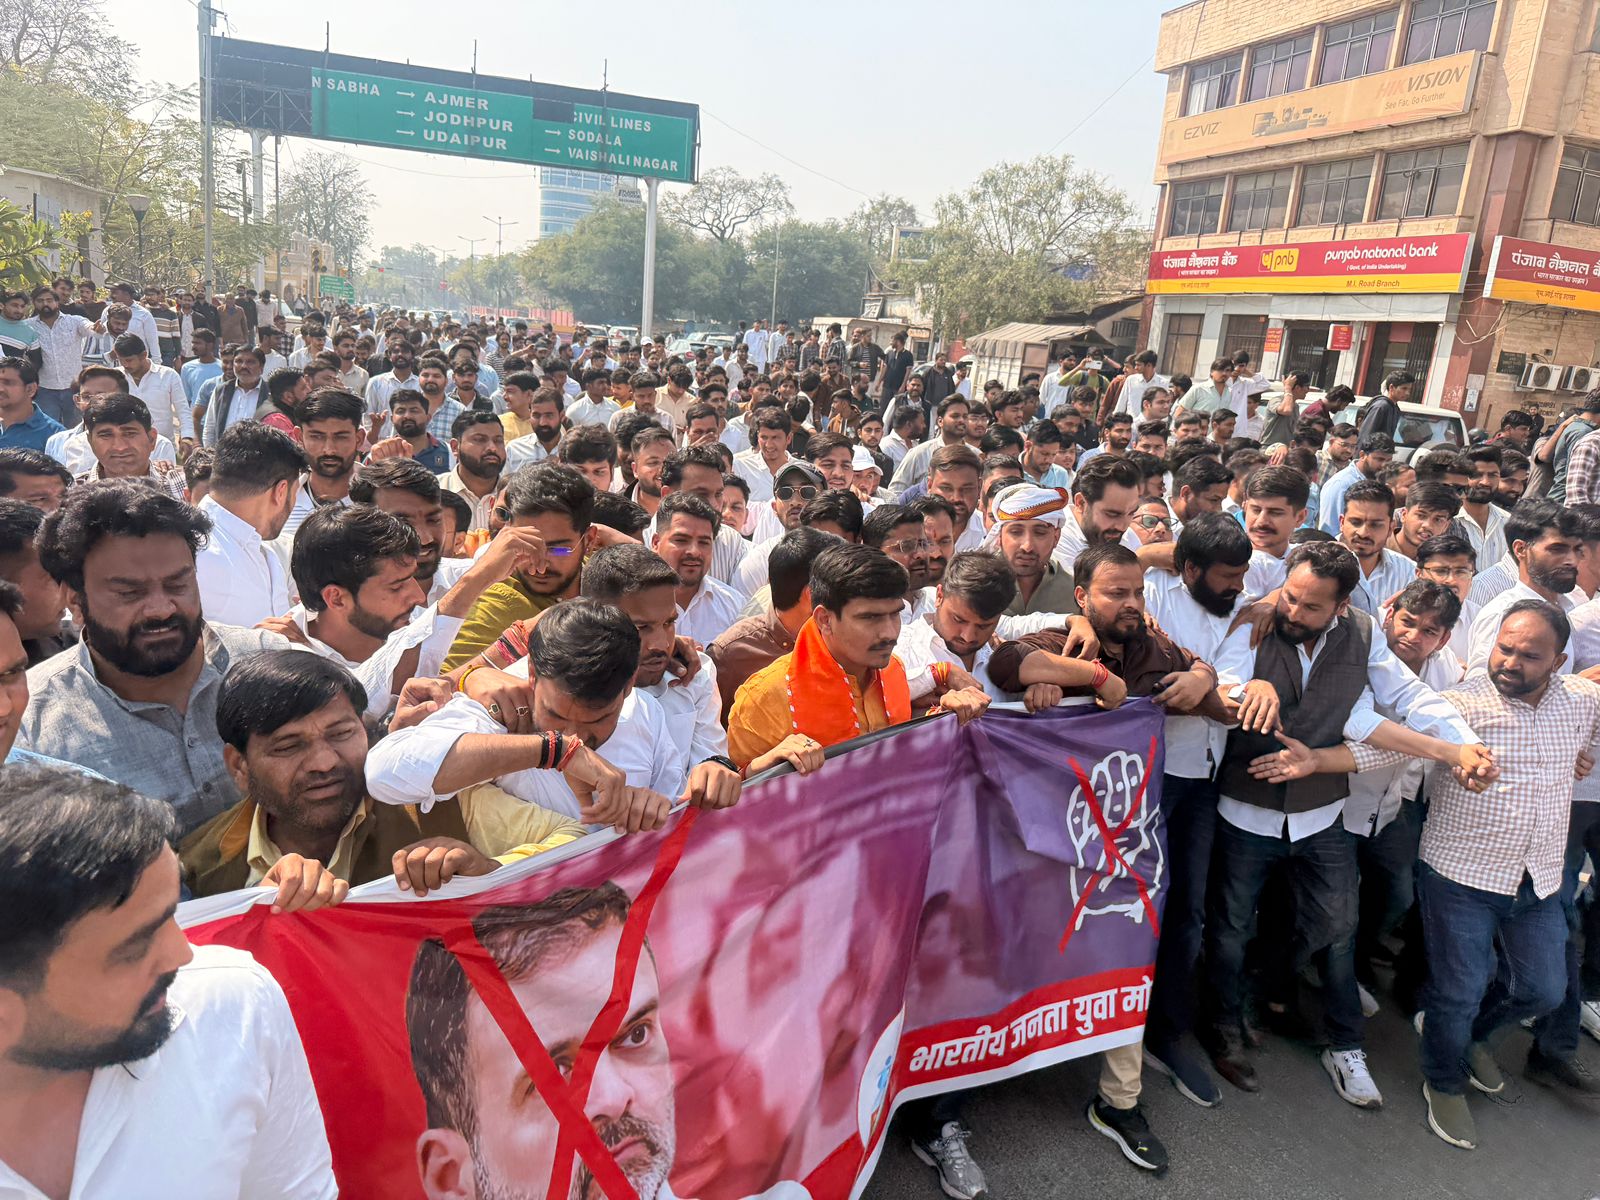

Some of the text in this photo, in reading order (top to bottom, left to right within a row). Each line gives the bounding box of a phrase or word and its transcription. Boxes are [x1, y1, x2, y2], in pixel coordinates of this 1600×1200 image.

[327, 78, 380, 96] SABHA
[1376, 66, 1465, 98] HIKVISION
[424, 91, 488, 110] AJMER
[1384, 101, 1396, 110] See
[1411, 96, 1420, 105] Go
[1421, 91, 1446, 104] Further
[424, 111, 513, 132] JODHPUR
[611, 116, 651, 132] LINES
[1184, 122, 1220, 140] EZVIZ
[423, 129, 507, 150] UDAIPUR
[568, 129, 622, 146] SODALA
[568, 147, 678, 172] VAISHALI NAGAR
[1163, 256, 1187, 269] पंजाब
[1273, 250, 1294, 270] pnb
[1324, 242, 1438, 264] punjab national bank
[1511, 249, 1546, 268] पंजाब
[909, 1025, 1009, 1072] भारतीय
[1010, 1000, 1071, 1048] जनता
[1072, 987, 1118, 1035] युवा
